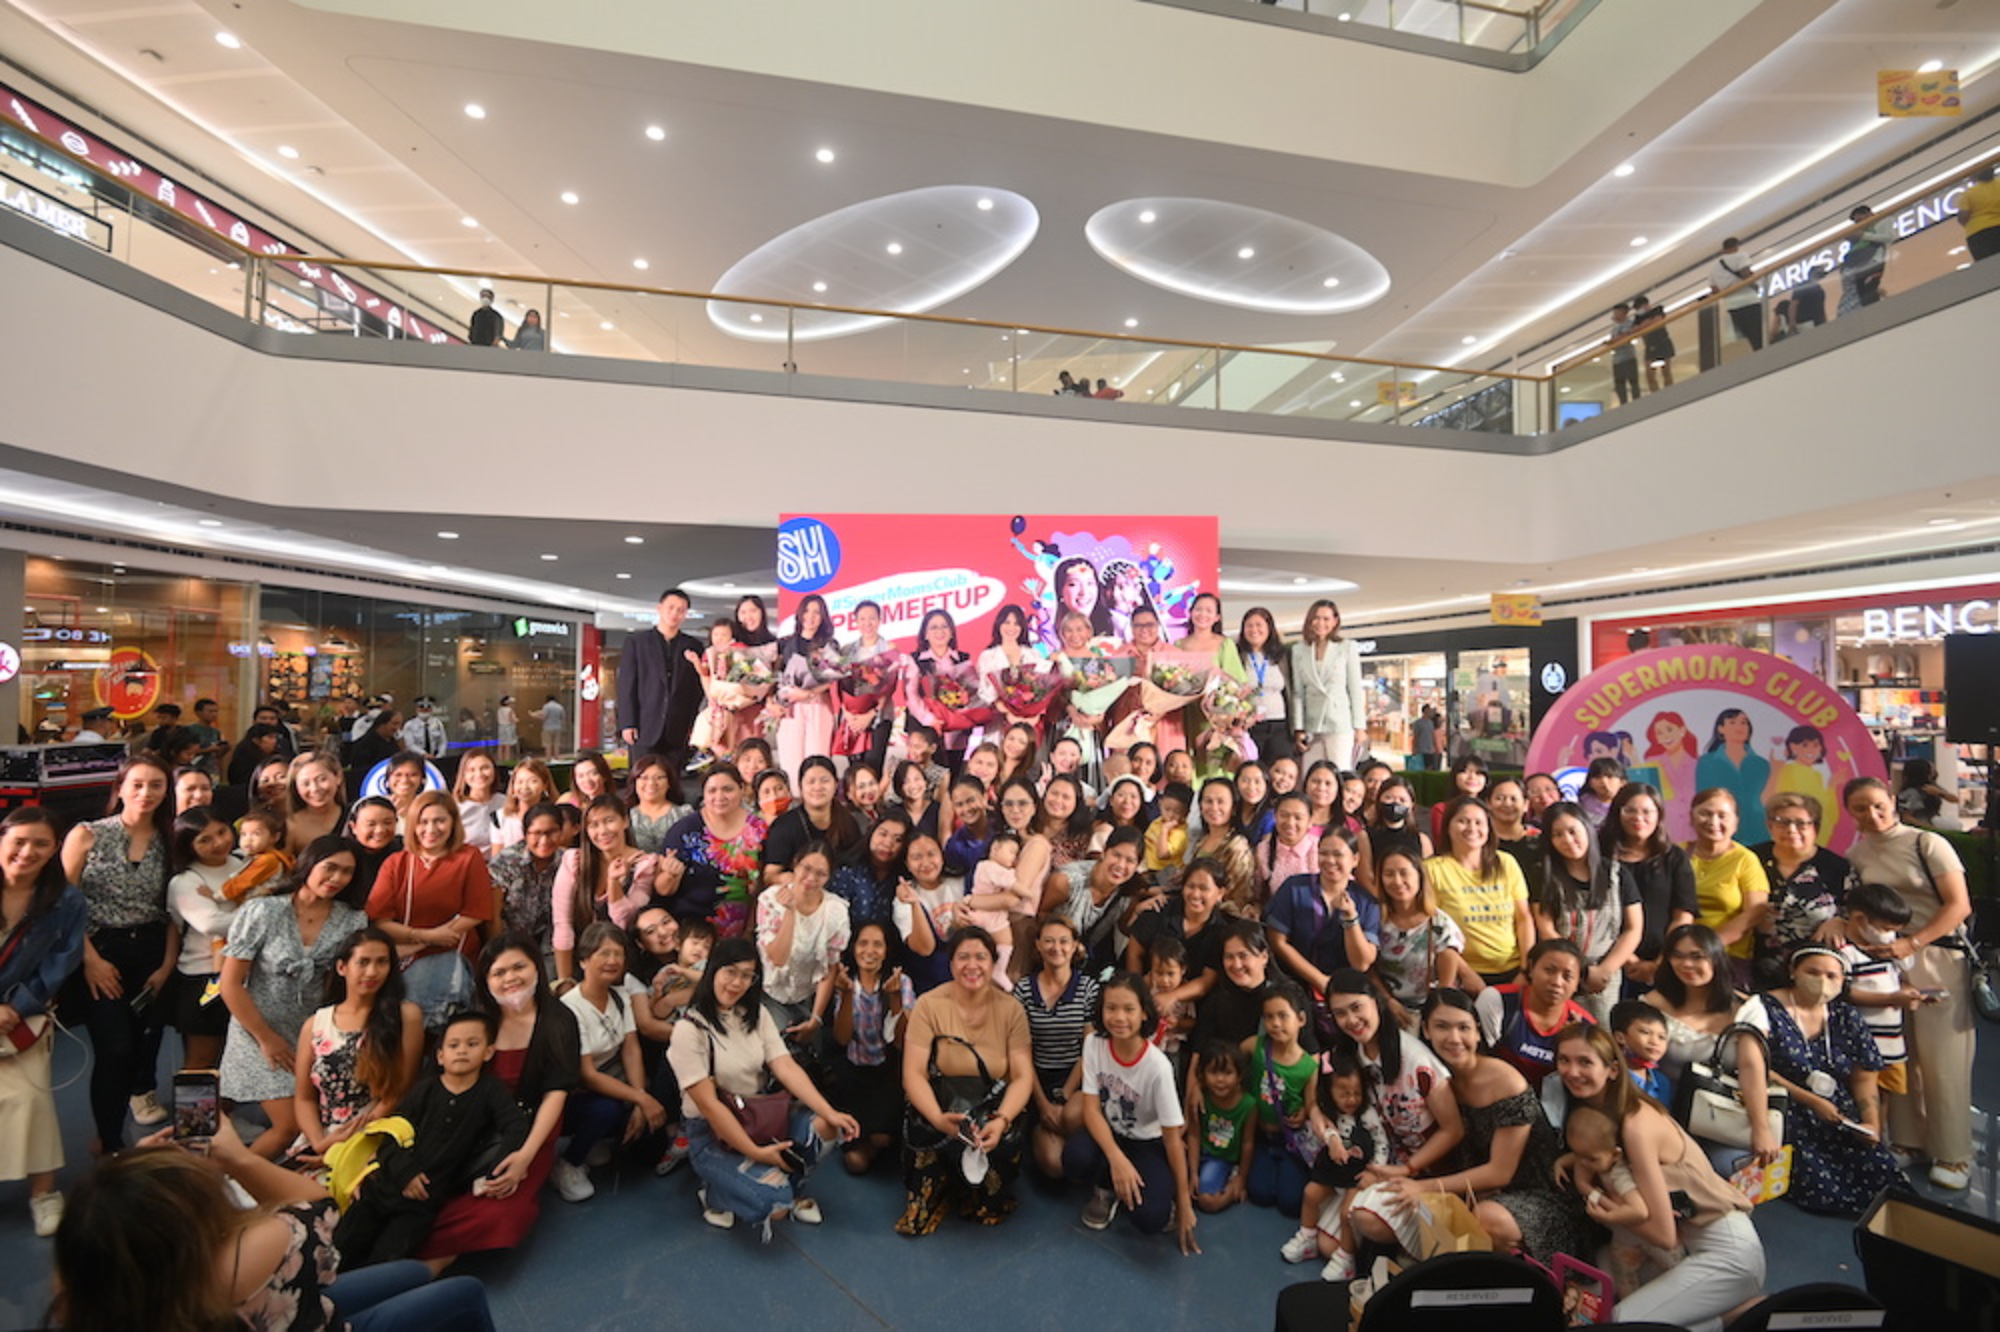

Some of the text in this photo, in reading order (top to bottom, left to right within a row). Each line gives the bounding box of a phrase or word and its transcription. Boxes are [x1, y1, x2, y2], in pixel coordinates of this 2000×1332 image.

[1757, 248, 1835, 298] ARKS
[777, 524, 833, 585] SM
[881, 584, 991, 625] MEETUP
[1863, 599, 2000, 639] BENC
[1575, 655, 1839, 730] SUPERMOMS CLUB
[1446, 1291, 1499, 1301] RESERVED
